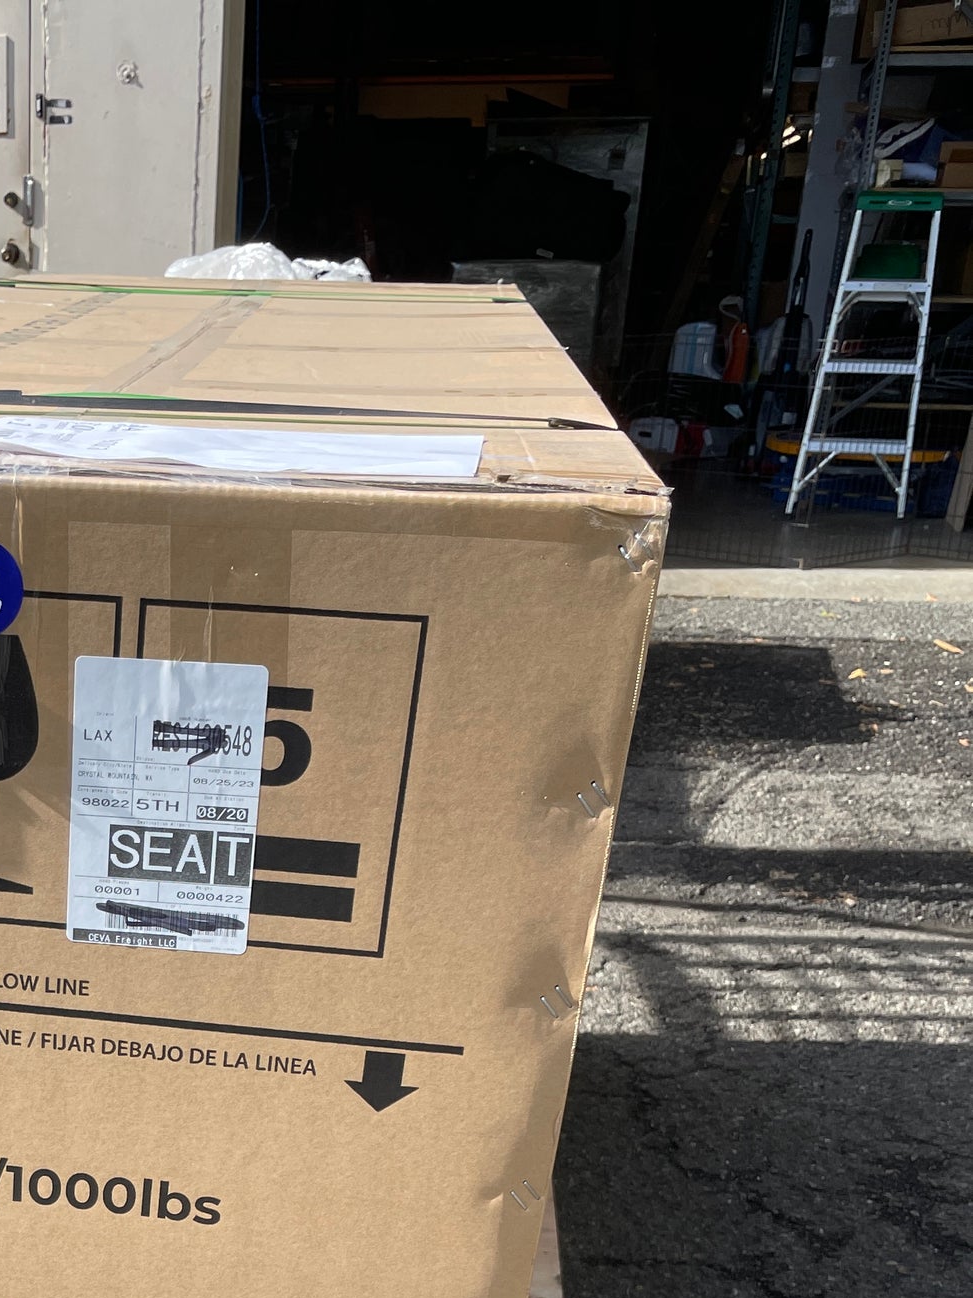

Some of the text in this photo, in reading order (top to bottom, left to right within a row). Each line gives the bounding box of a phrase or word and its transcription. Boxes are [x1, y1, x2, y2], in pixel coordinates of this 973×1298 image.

[83, 729, 113, 742] LAX
[78, 771, 105, 779] CRYSTAL
[193, 778, 254, 788] 08/25/23
[82, 798, 129, 808] 98022
[136, 798, 179, 812] 5TH
[197, 806, 246, 821] 08/20
[110, 829, 207, 875] SEA
[218, 835, 250, 877] T
[94, 885, 140, 896] 00001
[177, 891, 244, 903] 0000422
[88, 933, 110, 943] CEVA
[115, 935, 153, 948] Freight
[158, 939, 176, 948] LLC
[45, 976, 90, 997] LINE
[27, 1031, 37, 1049] /
[40, 1032, 95, 1054] FIJAR
[101, 1038, 183, 1063] DEBAJO
[189, 1047, 217, 1067] DE
[223, 1051, 249, 1070] LA
[254, 1054, 317, 1077] LINEA
